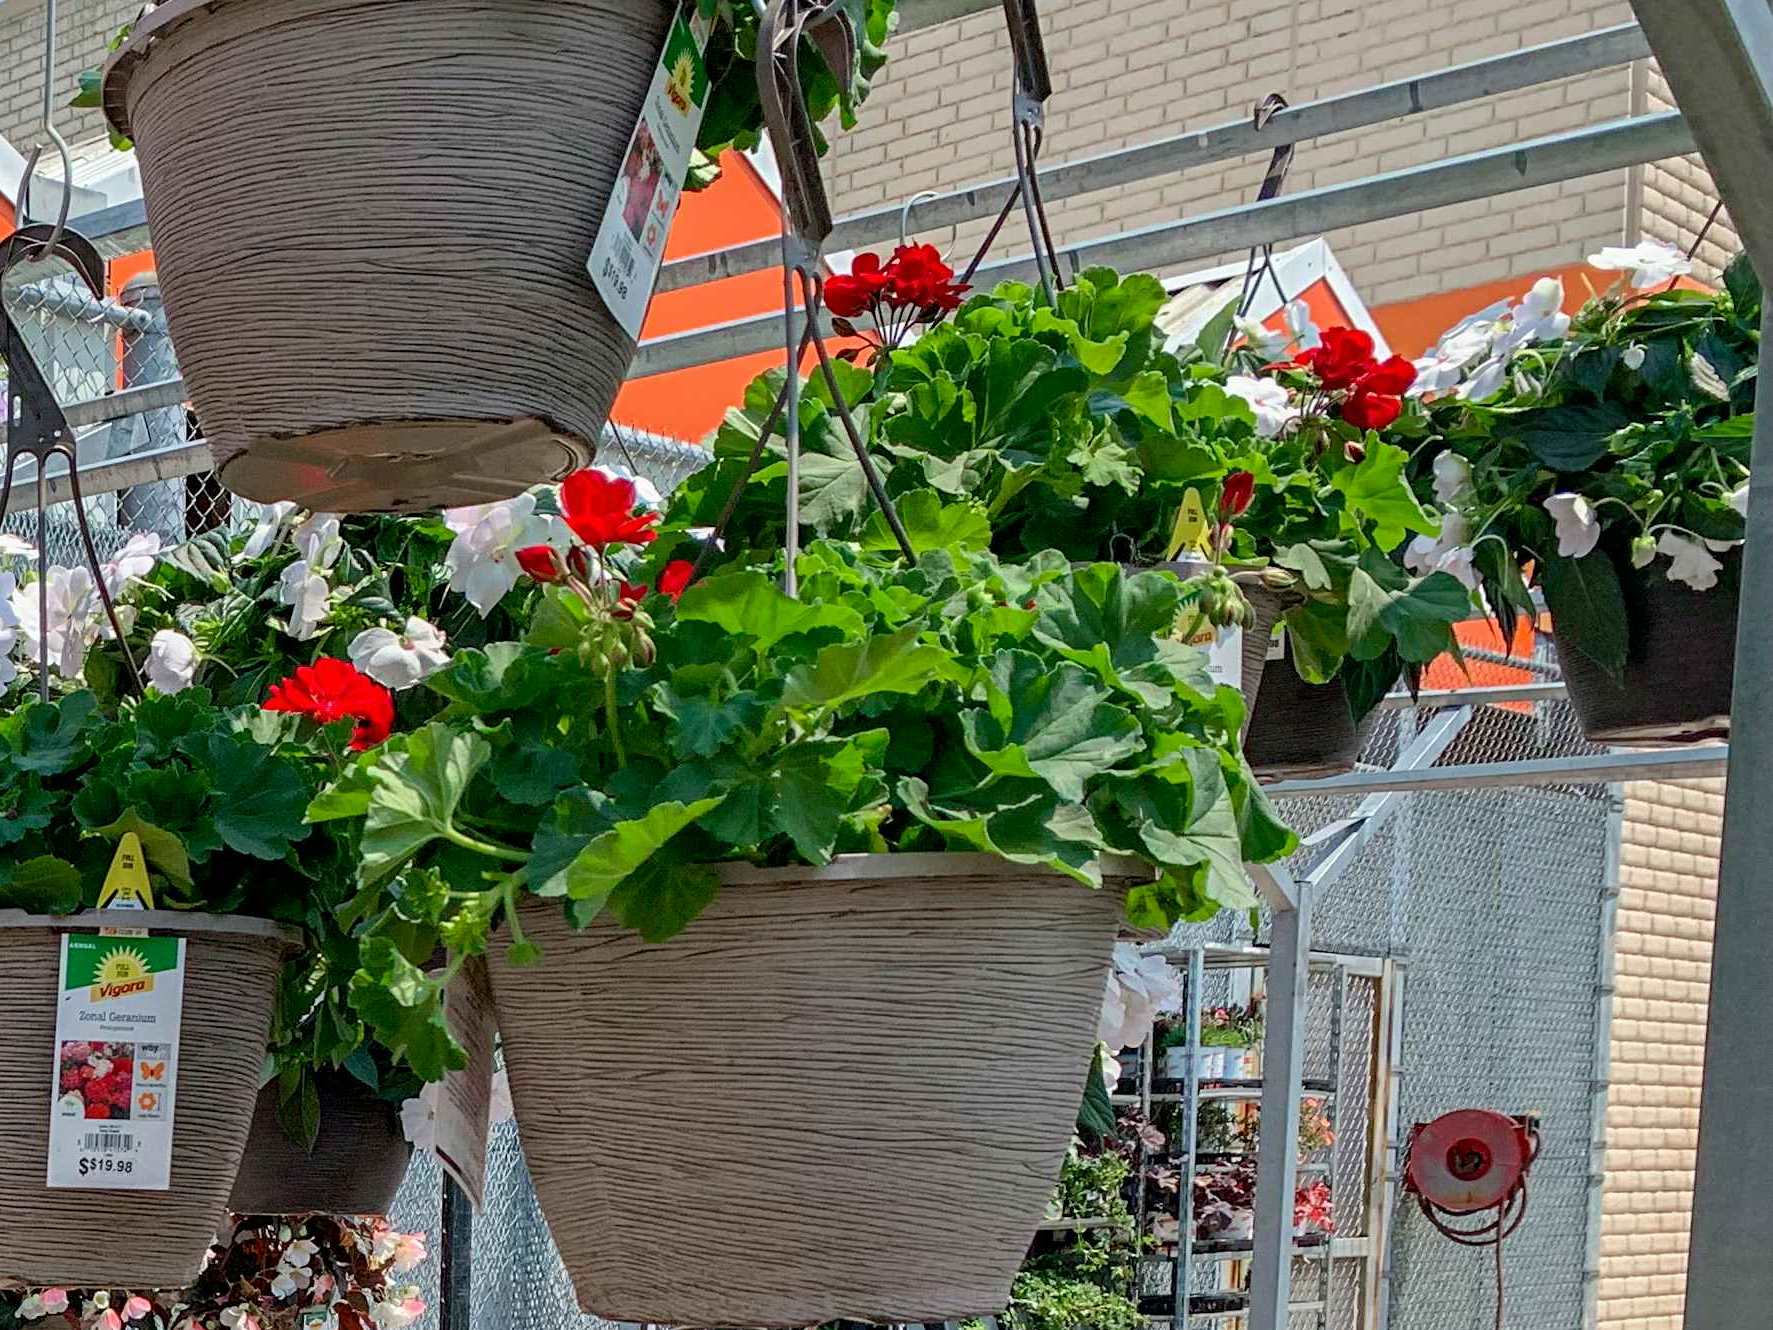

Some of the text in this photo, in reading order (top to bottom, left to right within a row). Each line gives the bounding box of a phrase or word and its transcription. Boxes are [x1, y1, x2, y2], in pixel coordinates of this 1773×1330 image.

[100, 980, 146, 998] Vigoro
[79, 1010, 157, 1024] Zonal Geranium
